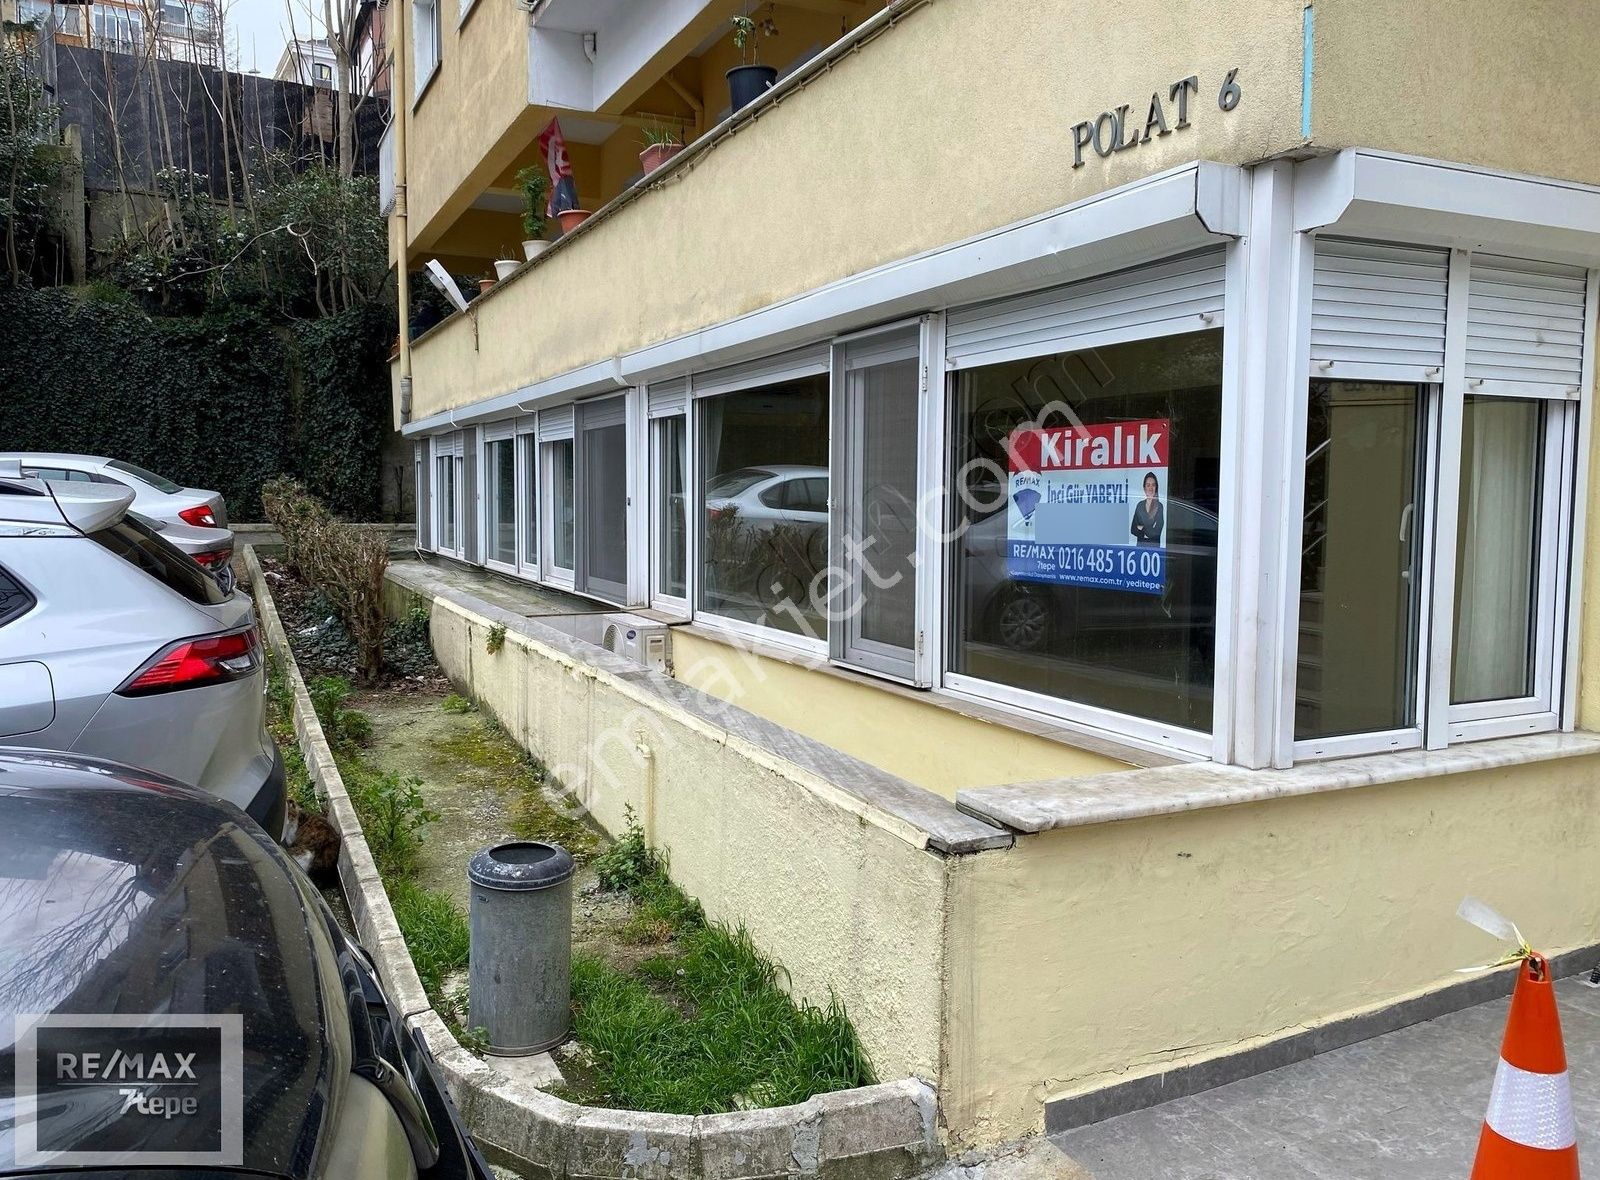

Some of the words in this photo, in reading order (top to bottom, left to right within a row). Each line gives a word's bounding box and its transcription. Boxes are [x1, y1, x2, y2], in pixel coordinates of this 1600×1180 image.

[1070, 75, 1198, 169] POLAT
[1218, 67, 1242, 112] 6
[1040, 424, 1162, 468] Kiralık
[1015, 477, 1041, 488] RE/MAX
[1047, 479, 1065, 503] İnci
[1066, 484, 1084, 503] Gür
[1013, 544, 1055, 560] RE/MAX
[1058, 546, 1084, 571] 0216
[1086, 548, 1114, 573] 485
[1117, 550, 1136, 576] 16
[1140, 551, 1161, 577] 00
[1037, 560, 1056, 571] 7tepe
